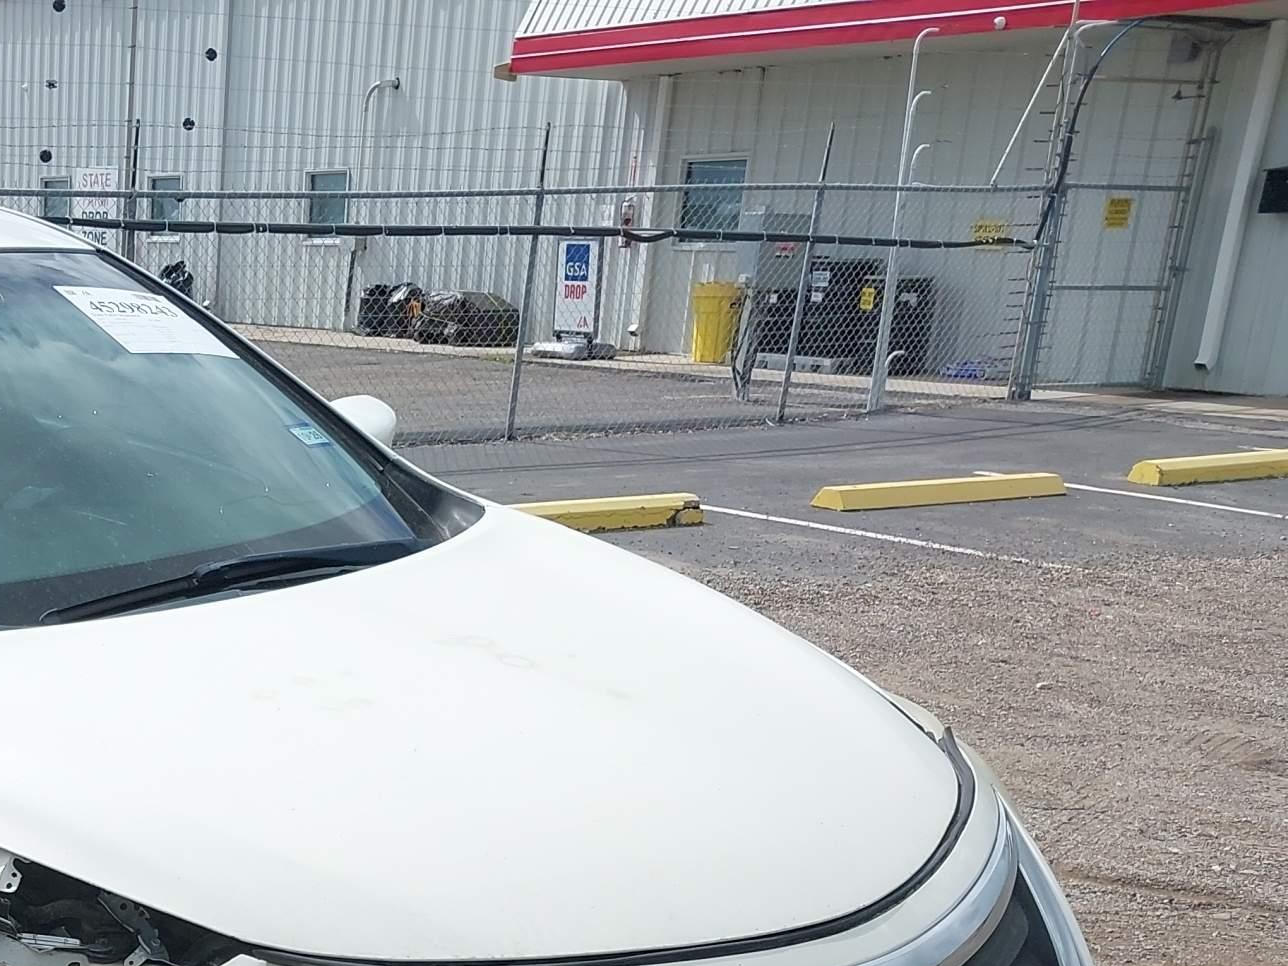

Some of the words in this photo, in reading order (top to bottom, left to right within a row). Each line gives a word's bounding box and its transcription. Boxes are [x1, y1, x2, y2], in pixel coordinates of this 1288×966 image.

[82, 173, 112, 188] STATE
[566, 262, 587, 276] GSA
[564, 284, 587, 300] DROP
[89, 300, 179, 318] 45298243
